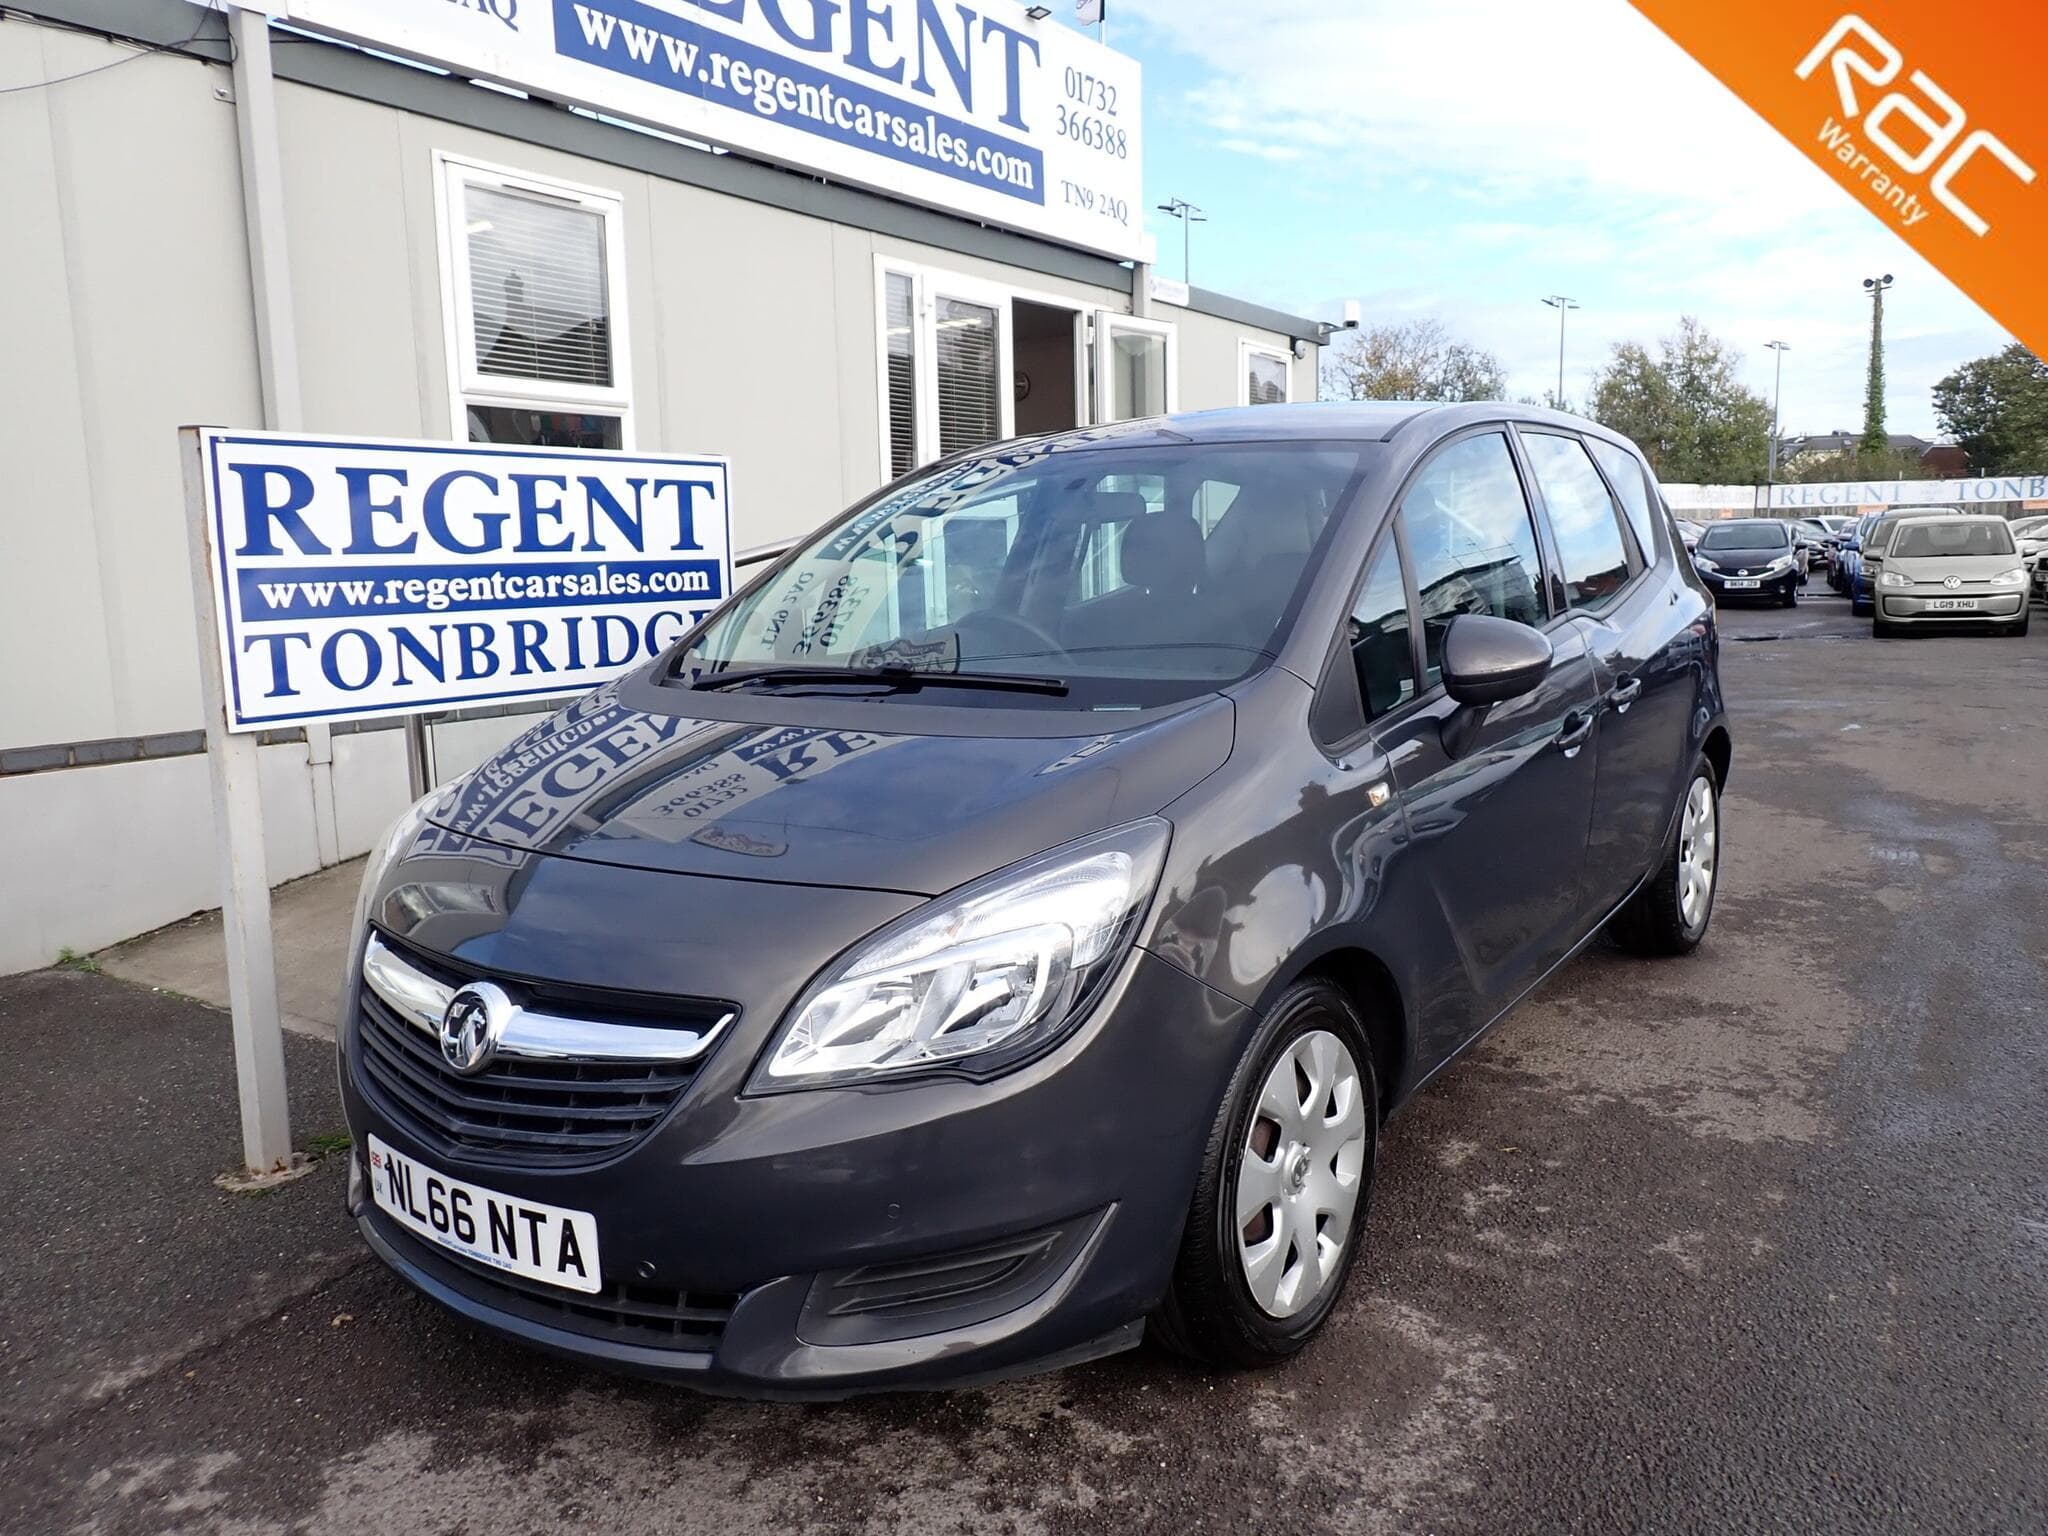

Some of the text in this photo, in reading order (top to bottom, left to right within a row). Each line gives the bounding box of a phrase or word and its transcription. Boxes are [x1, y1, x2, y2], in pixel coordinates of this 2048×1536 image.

[683, 0, 1041, 133] ENT
[1065, 66, 1118, 116] 01732
[573, 4, 1034, 190] www.regentcarsales.com
[1056, 104, 1127, 159] 366388
[1061, 179, 1128, 227] TN9 2AQ
[228, 462, 716, 557] REGENT
[1780, 484, 1905, 505] REGENT
[259, 564, 711, 610] www.regentcarsales.com
[1933, 600, 1975, 609] LG19 XHU
[384, 1153, 587, 1278] NL66 NTA
